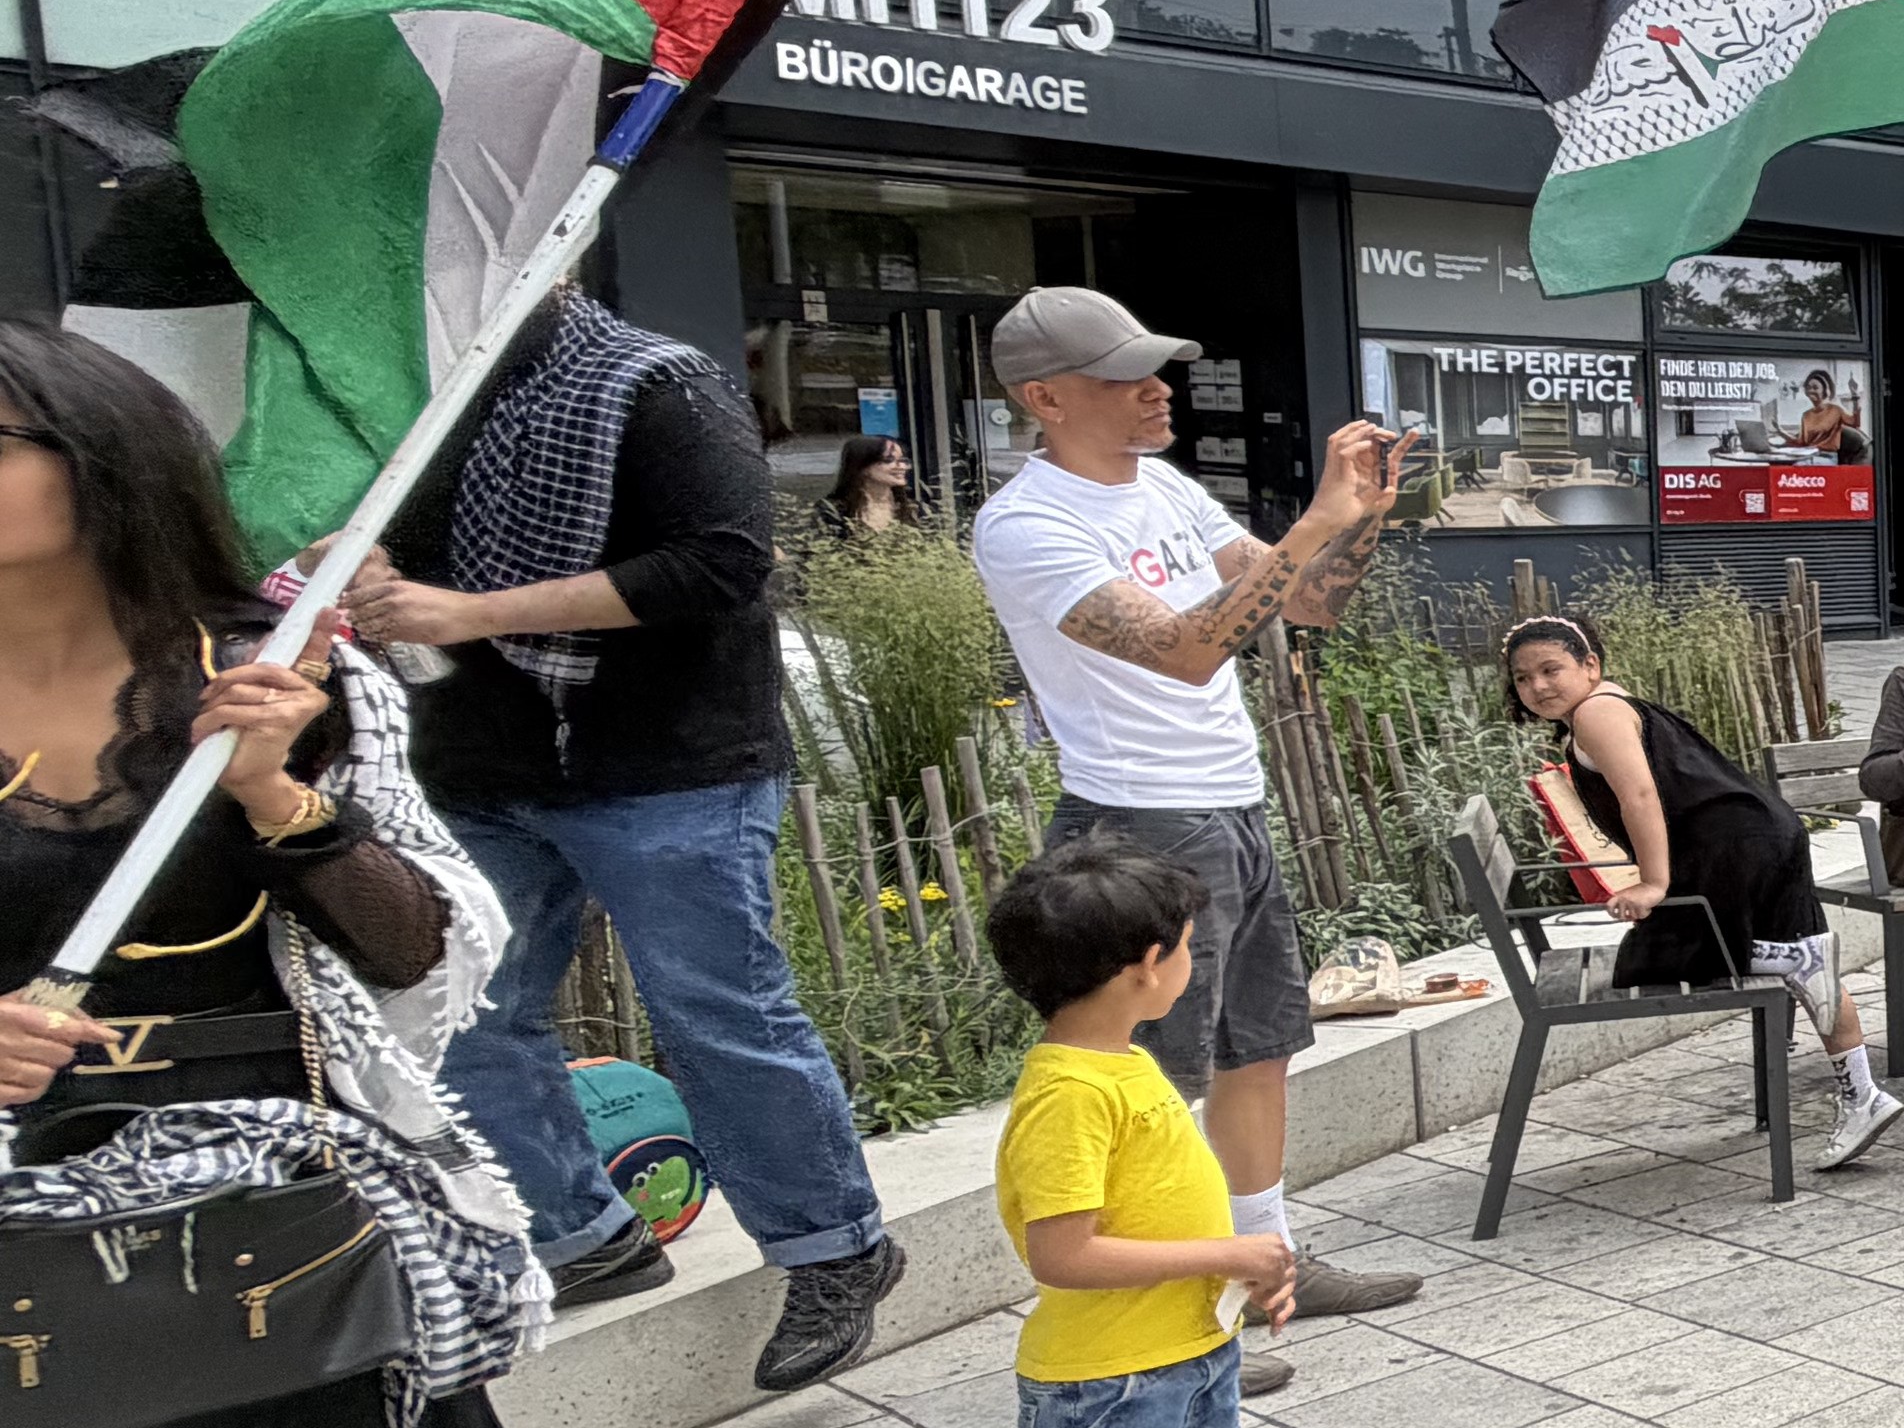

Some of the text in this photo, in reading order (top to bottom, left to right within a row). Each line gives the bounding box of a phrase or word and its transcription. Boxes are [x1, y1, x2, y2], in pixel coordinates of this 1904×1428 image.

[1360, 247, 1426, 278] IWG
[1436, 349, 1635, 377] THE PERFECT
[1660, 359, 1779, 381] FINDE HIER DEN JOB,
[1527, 376, 1633, 402] OFFICE
[1661, 380, 1751, 399] DEN DU LIEBST!
[1664, 473, 1721, 489] DIS AG
[1777, 473, 1826, 488] Adecco
